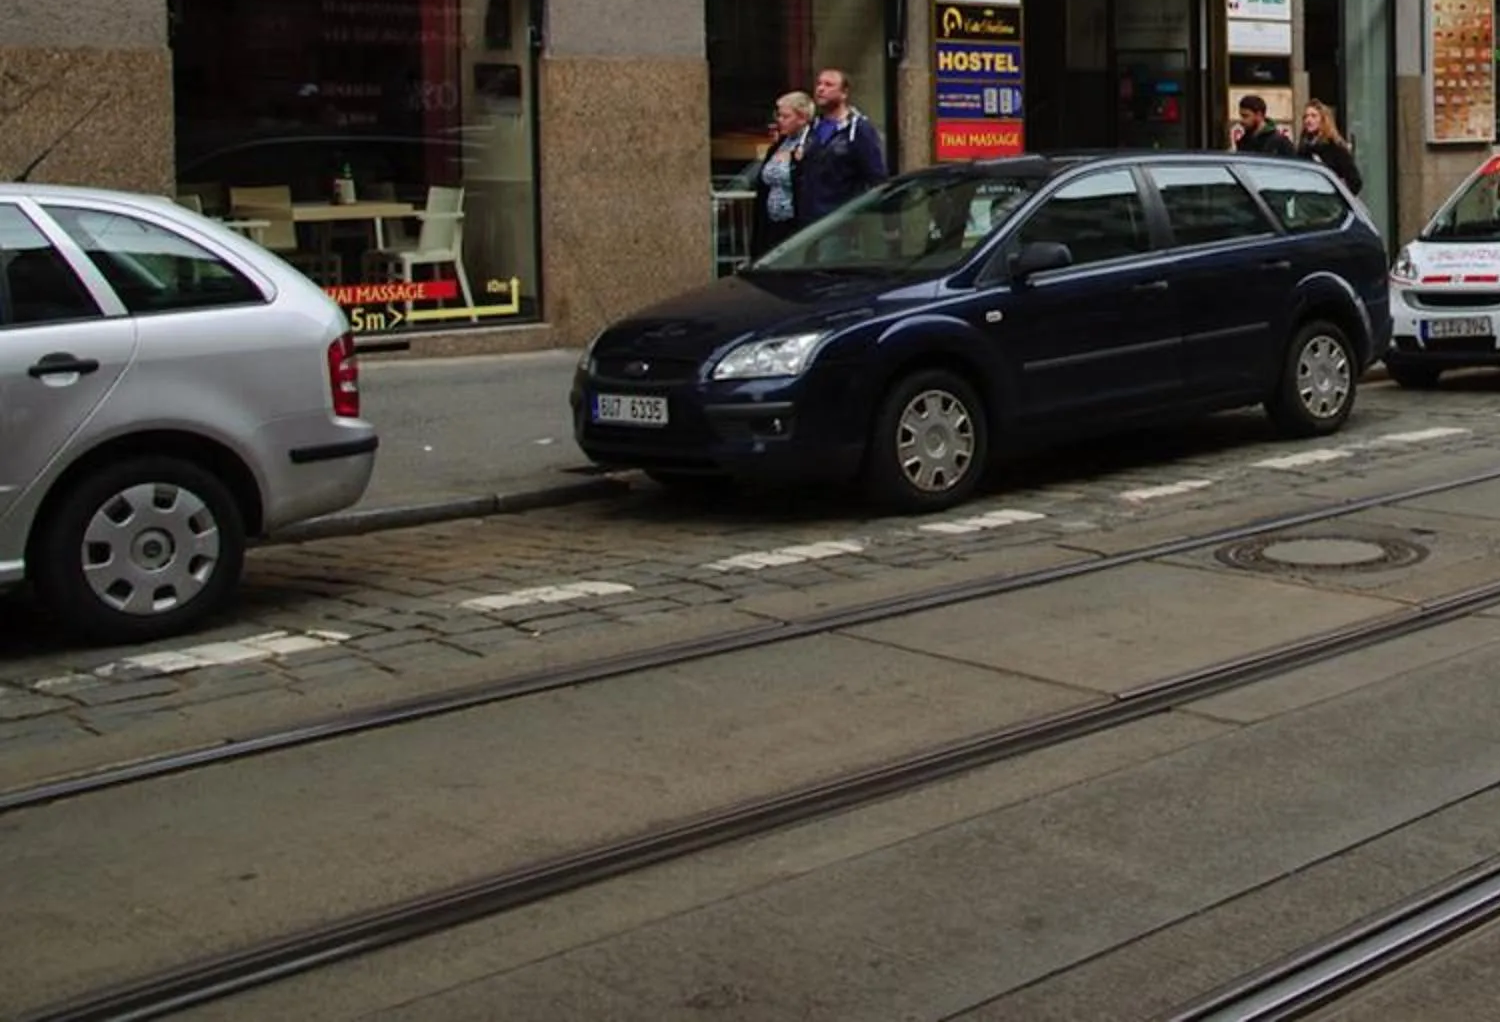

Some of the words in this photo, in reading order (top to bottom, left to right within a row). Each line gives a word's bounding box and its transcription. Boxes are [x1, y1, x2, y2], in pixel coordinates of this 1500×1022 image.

[937, 50, 1020, 74] HOSTEL
[940, 132, 967, 147] THAI
[969, 133, 1020, 148] MASSAGE
[355, 282, 427, 303] MASSAGE
